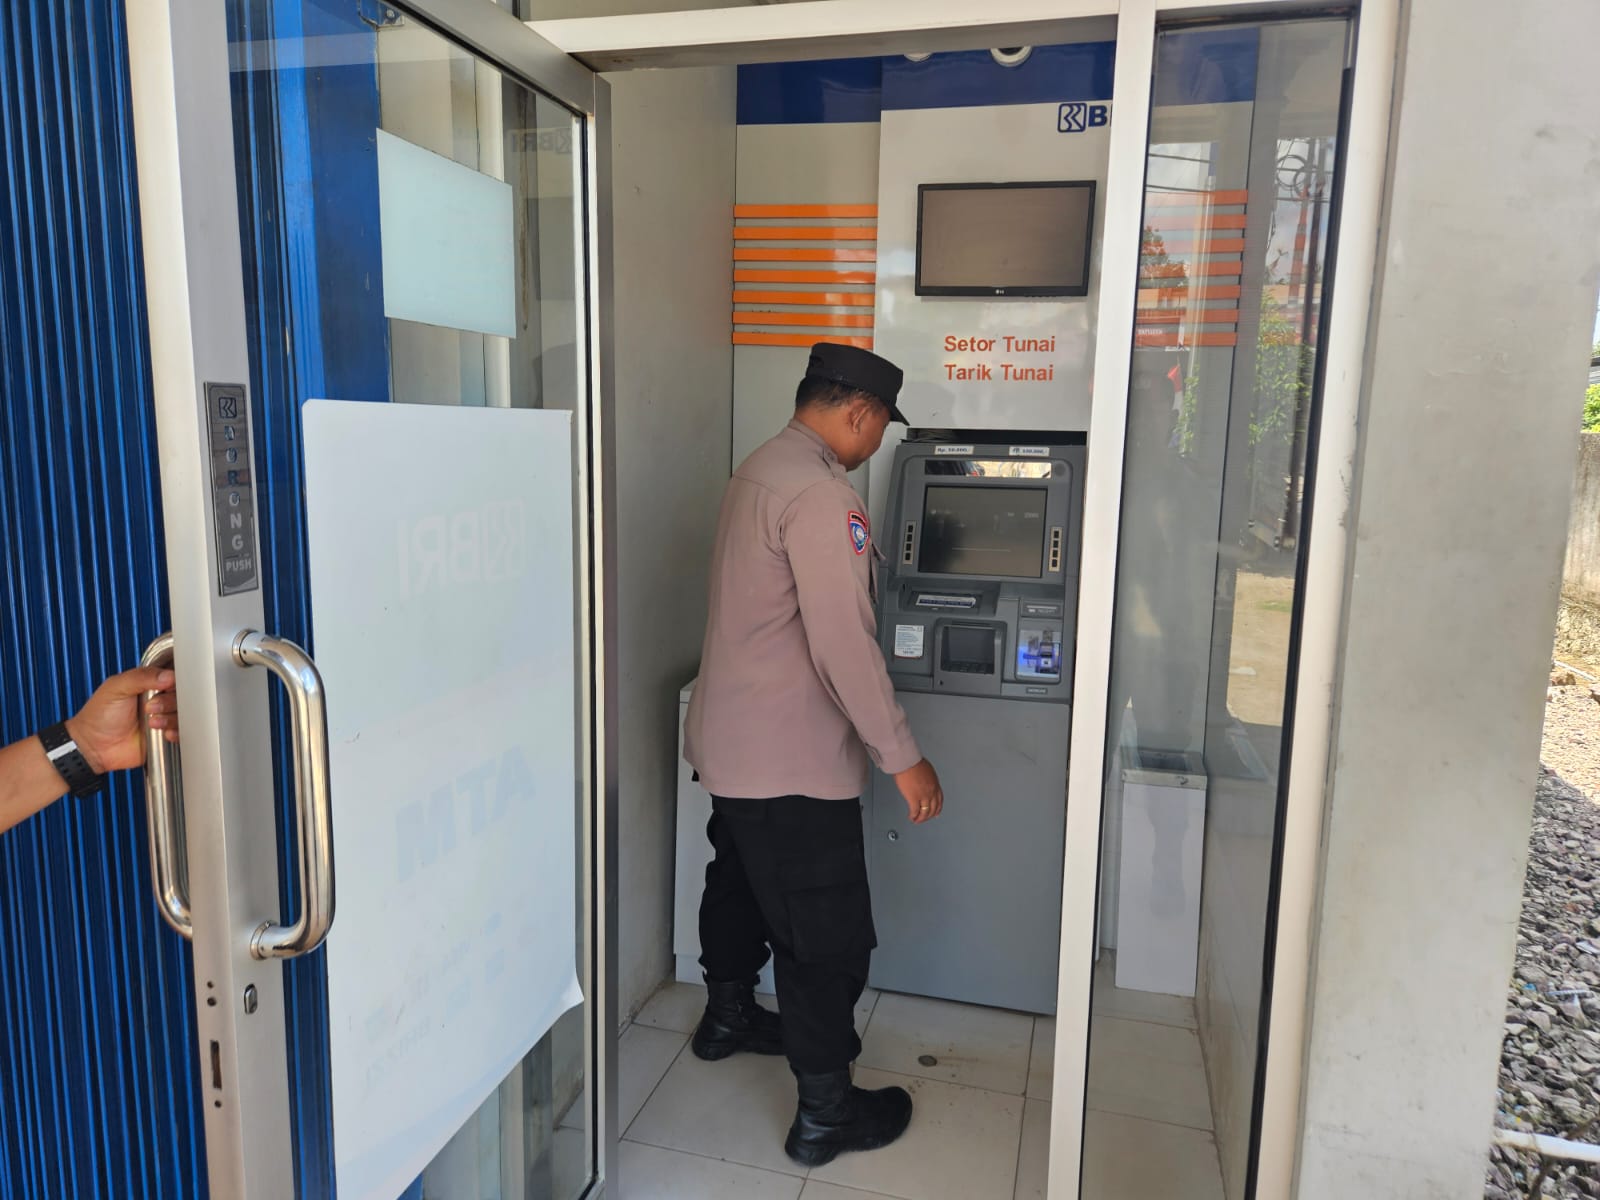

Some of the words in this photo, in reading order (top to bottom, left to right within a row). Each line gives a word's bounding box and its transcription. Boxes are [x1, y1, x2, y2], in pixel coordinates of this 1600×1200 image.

[944, 335, 996, 352] Setor
[1002, 335, 1055, 352] Tunai
[944, 363, 992, 381] Tarik
[1000, 364, 1054, 381] Tunai
[223, 425, 244, 551] DORONG
[225, 558, 252, 572] PUSH
